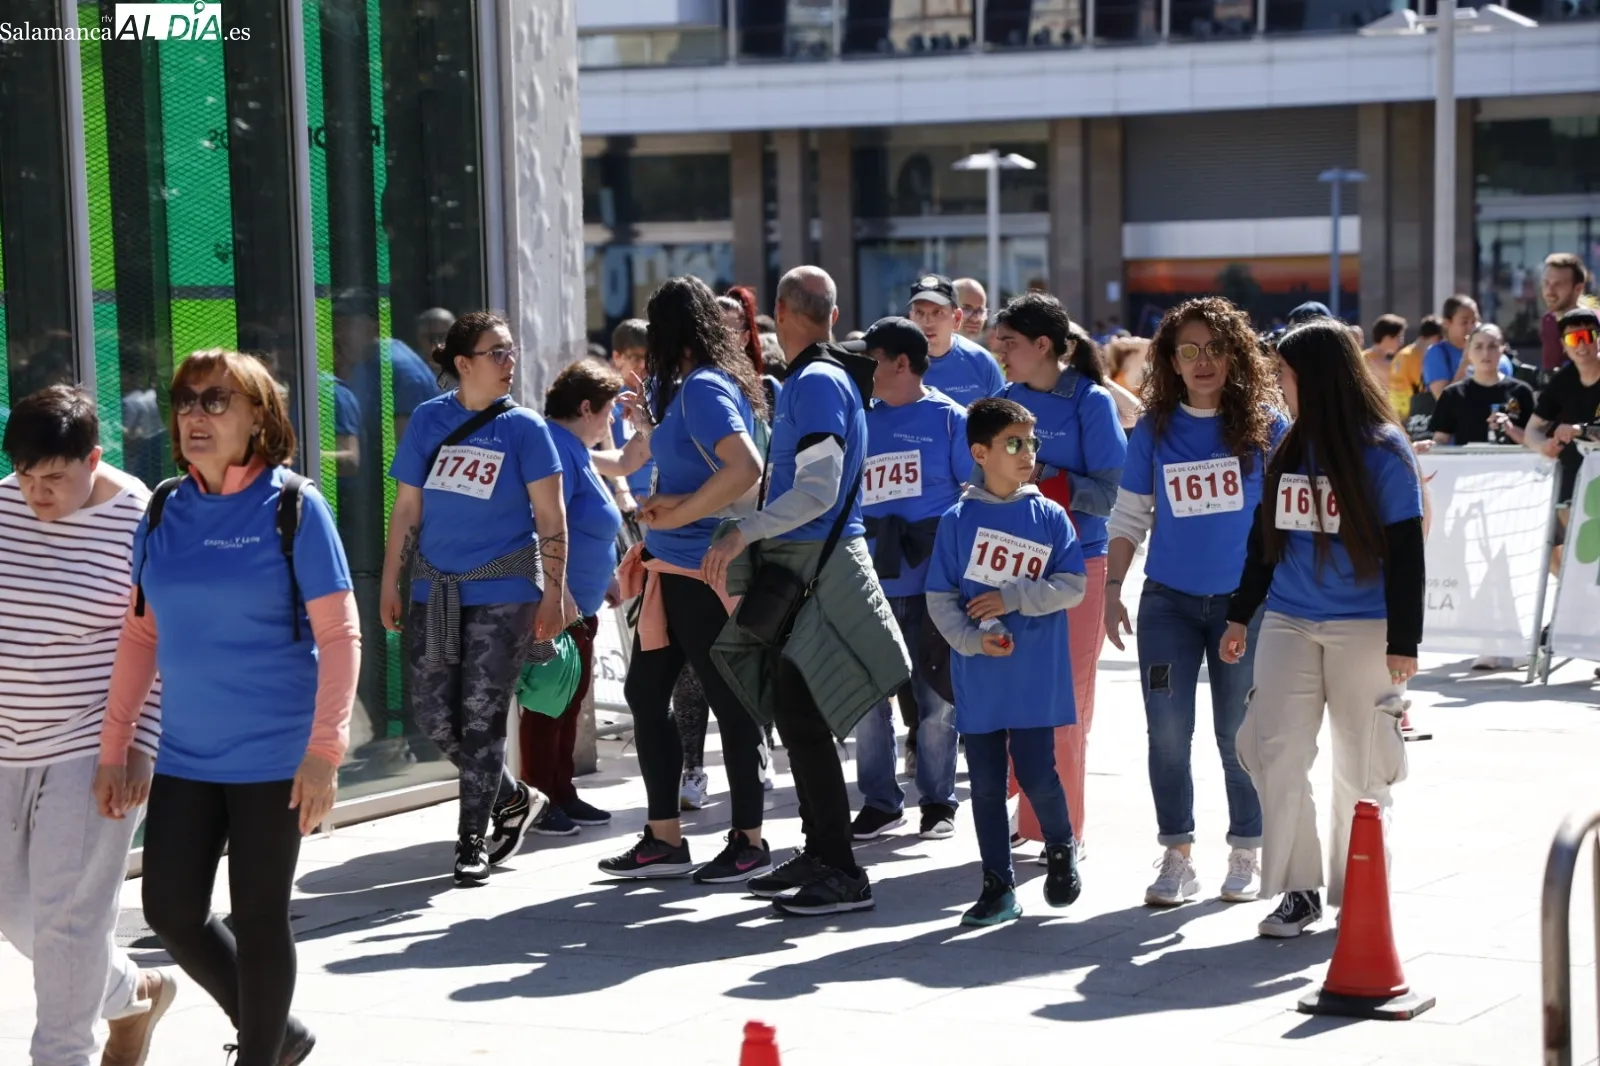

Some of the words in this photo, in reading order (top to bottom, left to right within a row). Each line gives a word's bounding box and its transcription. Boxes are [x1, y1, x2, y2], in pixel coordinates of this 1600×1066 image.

[459, 449, 481, 457] CASTILLA
[876, 455, 899, 464] CASTILLA
[436, 456, 497, 485] 1743
[864, 461, 918, 491] 1745
[1166, 466, 1176, 474] DÍA
[1187, 463, 1215, 471] CASTILLA
[1220, 460, 1237, 468] LEÓN
[1169, 470, 1239, 502] 1618
[979, 530, 989, 539] DÍA
[1000, 536, 1026, 549] CASTILLA
[1032, 546, 1048, 556] LEÓN
[976, 541, 1043, 582] 1619
[1427, 593, 1455, 611] LA
